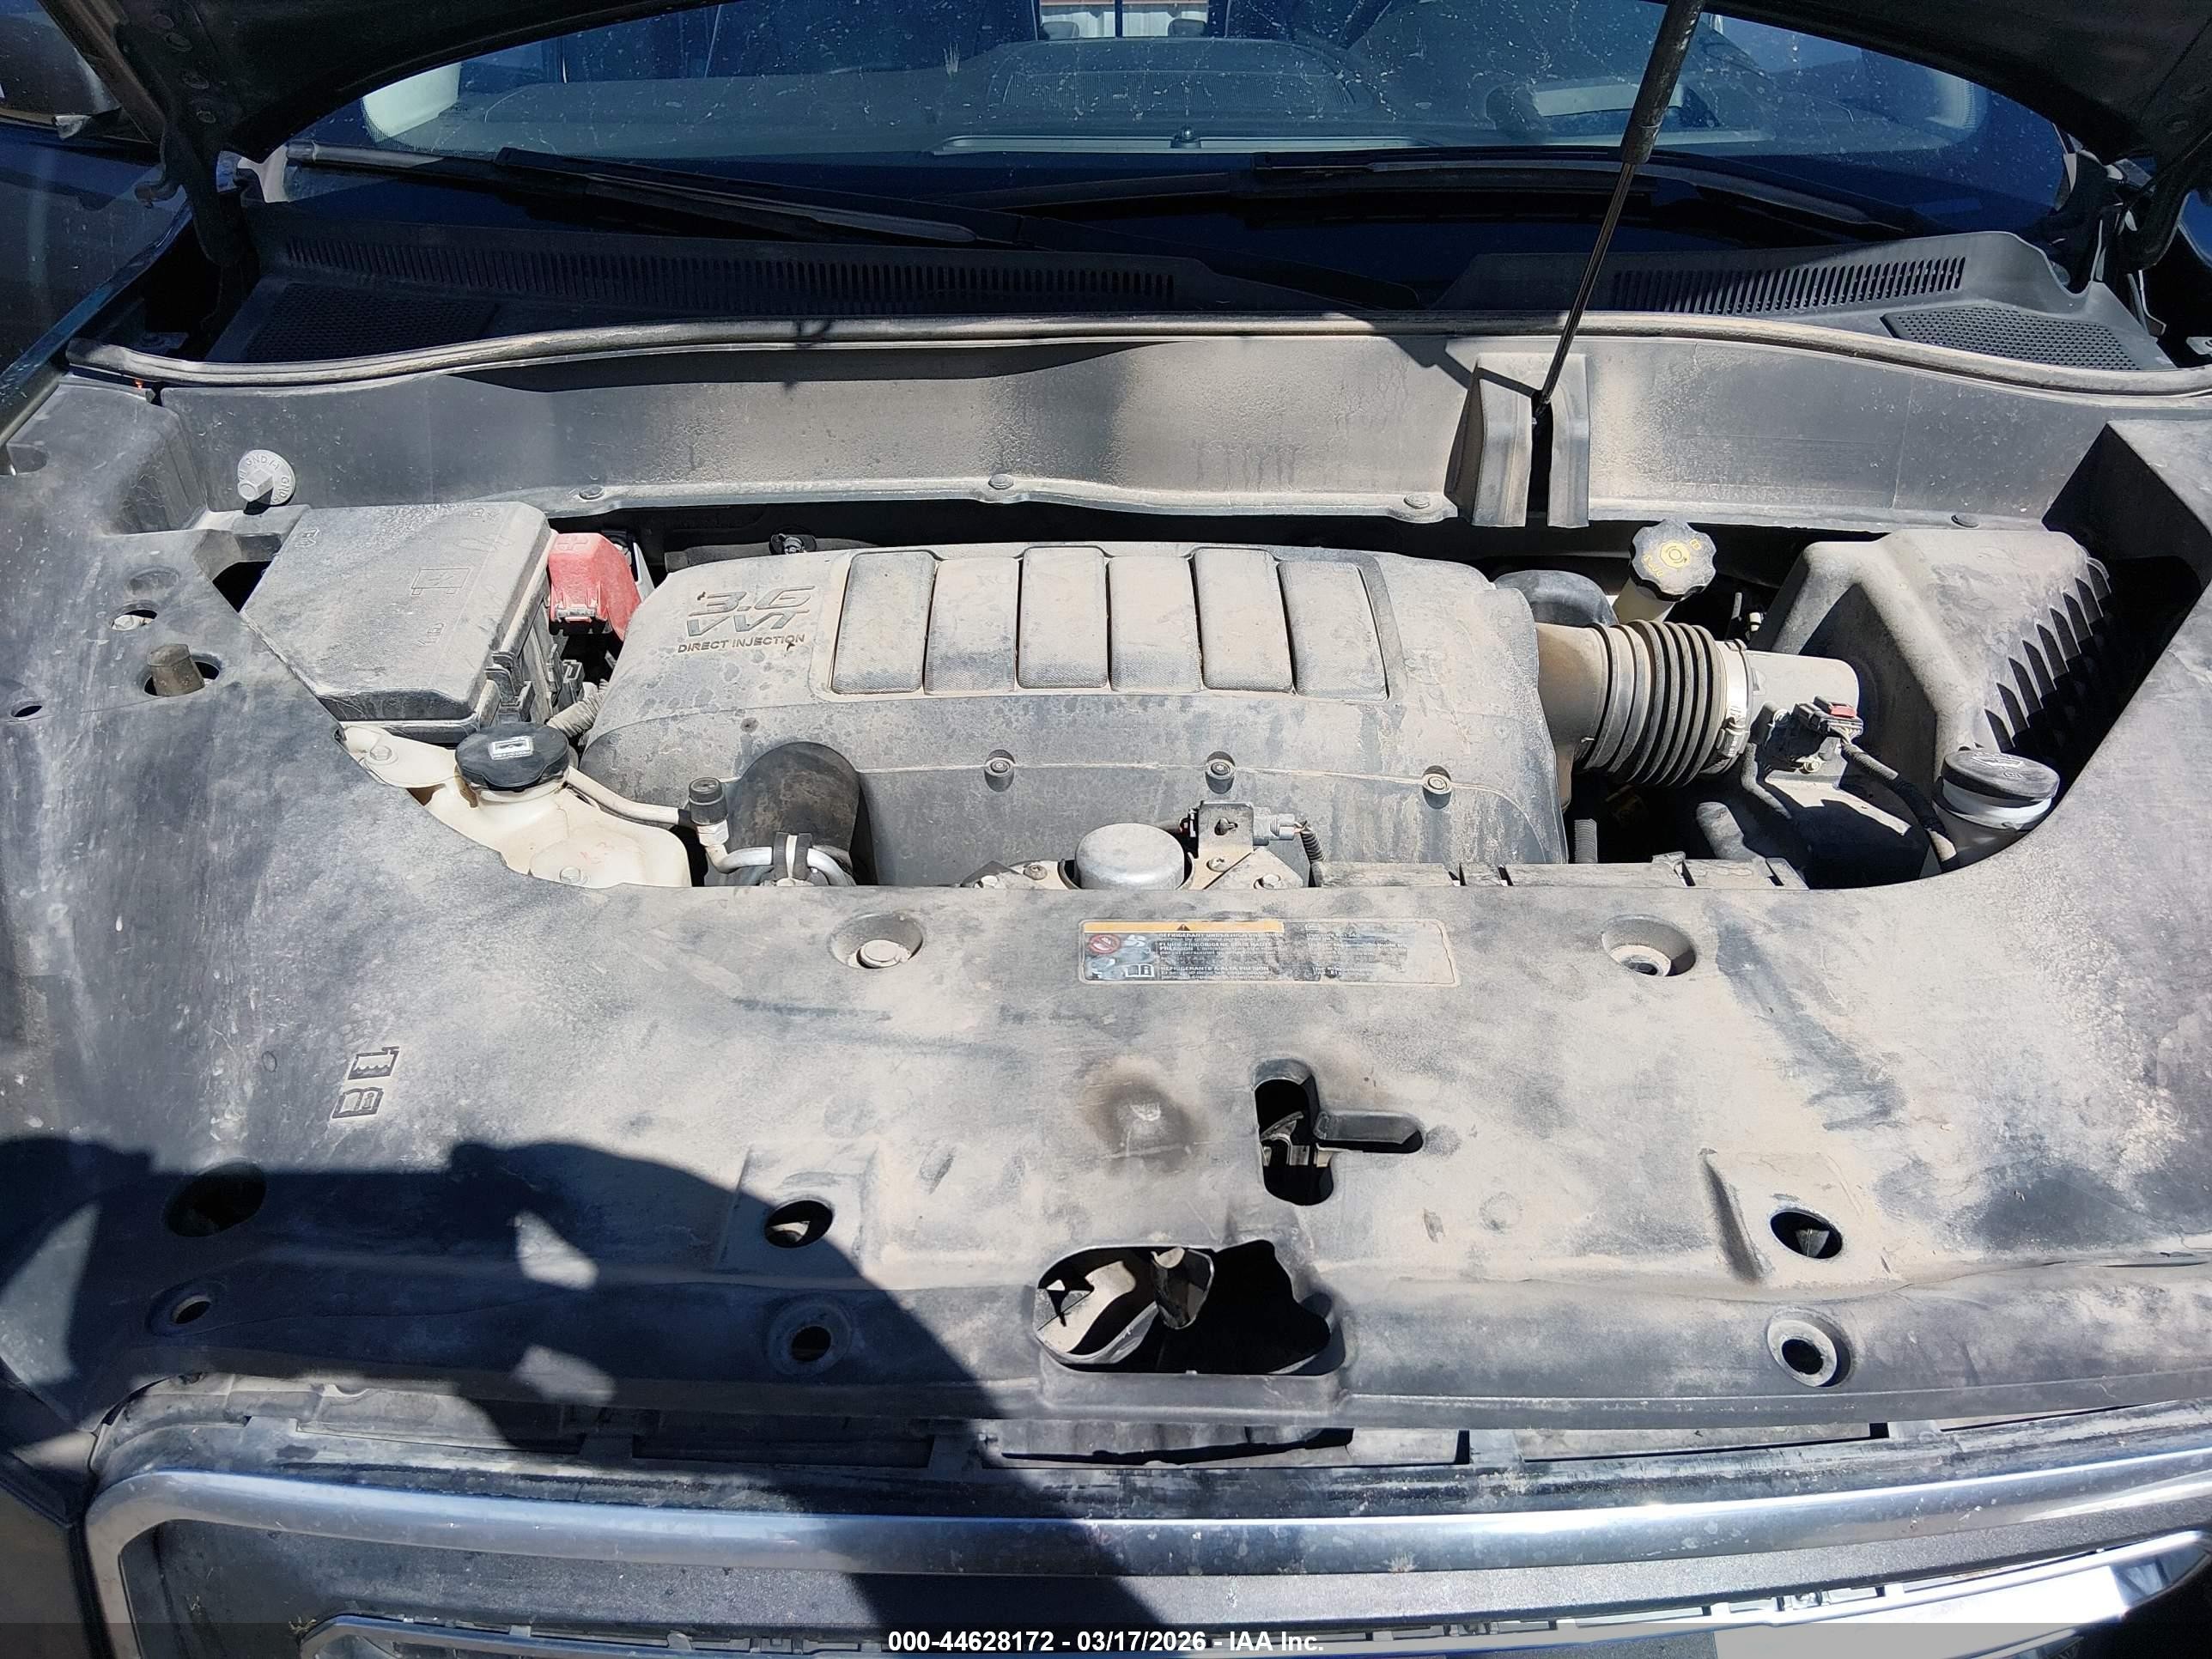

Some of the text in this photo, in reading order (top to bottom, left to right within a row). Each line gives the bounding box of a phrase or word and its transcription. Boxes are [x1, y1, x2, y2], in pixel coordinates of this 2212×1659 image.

[688, 586, 815, 617] 3.6
[687, 610, 810, 636] VVT
[678, 634, 805, 653] DIRECT INJECTION
